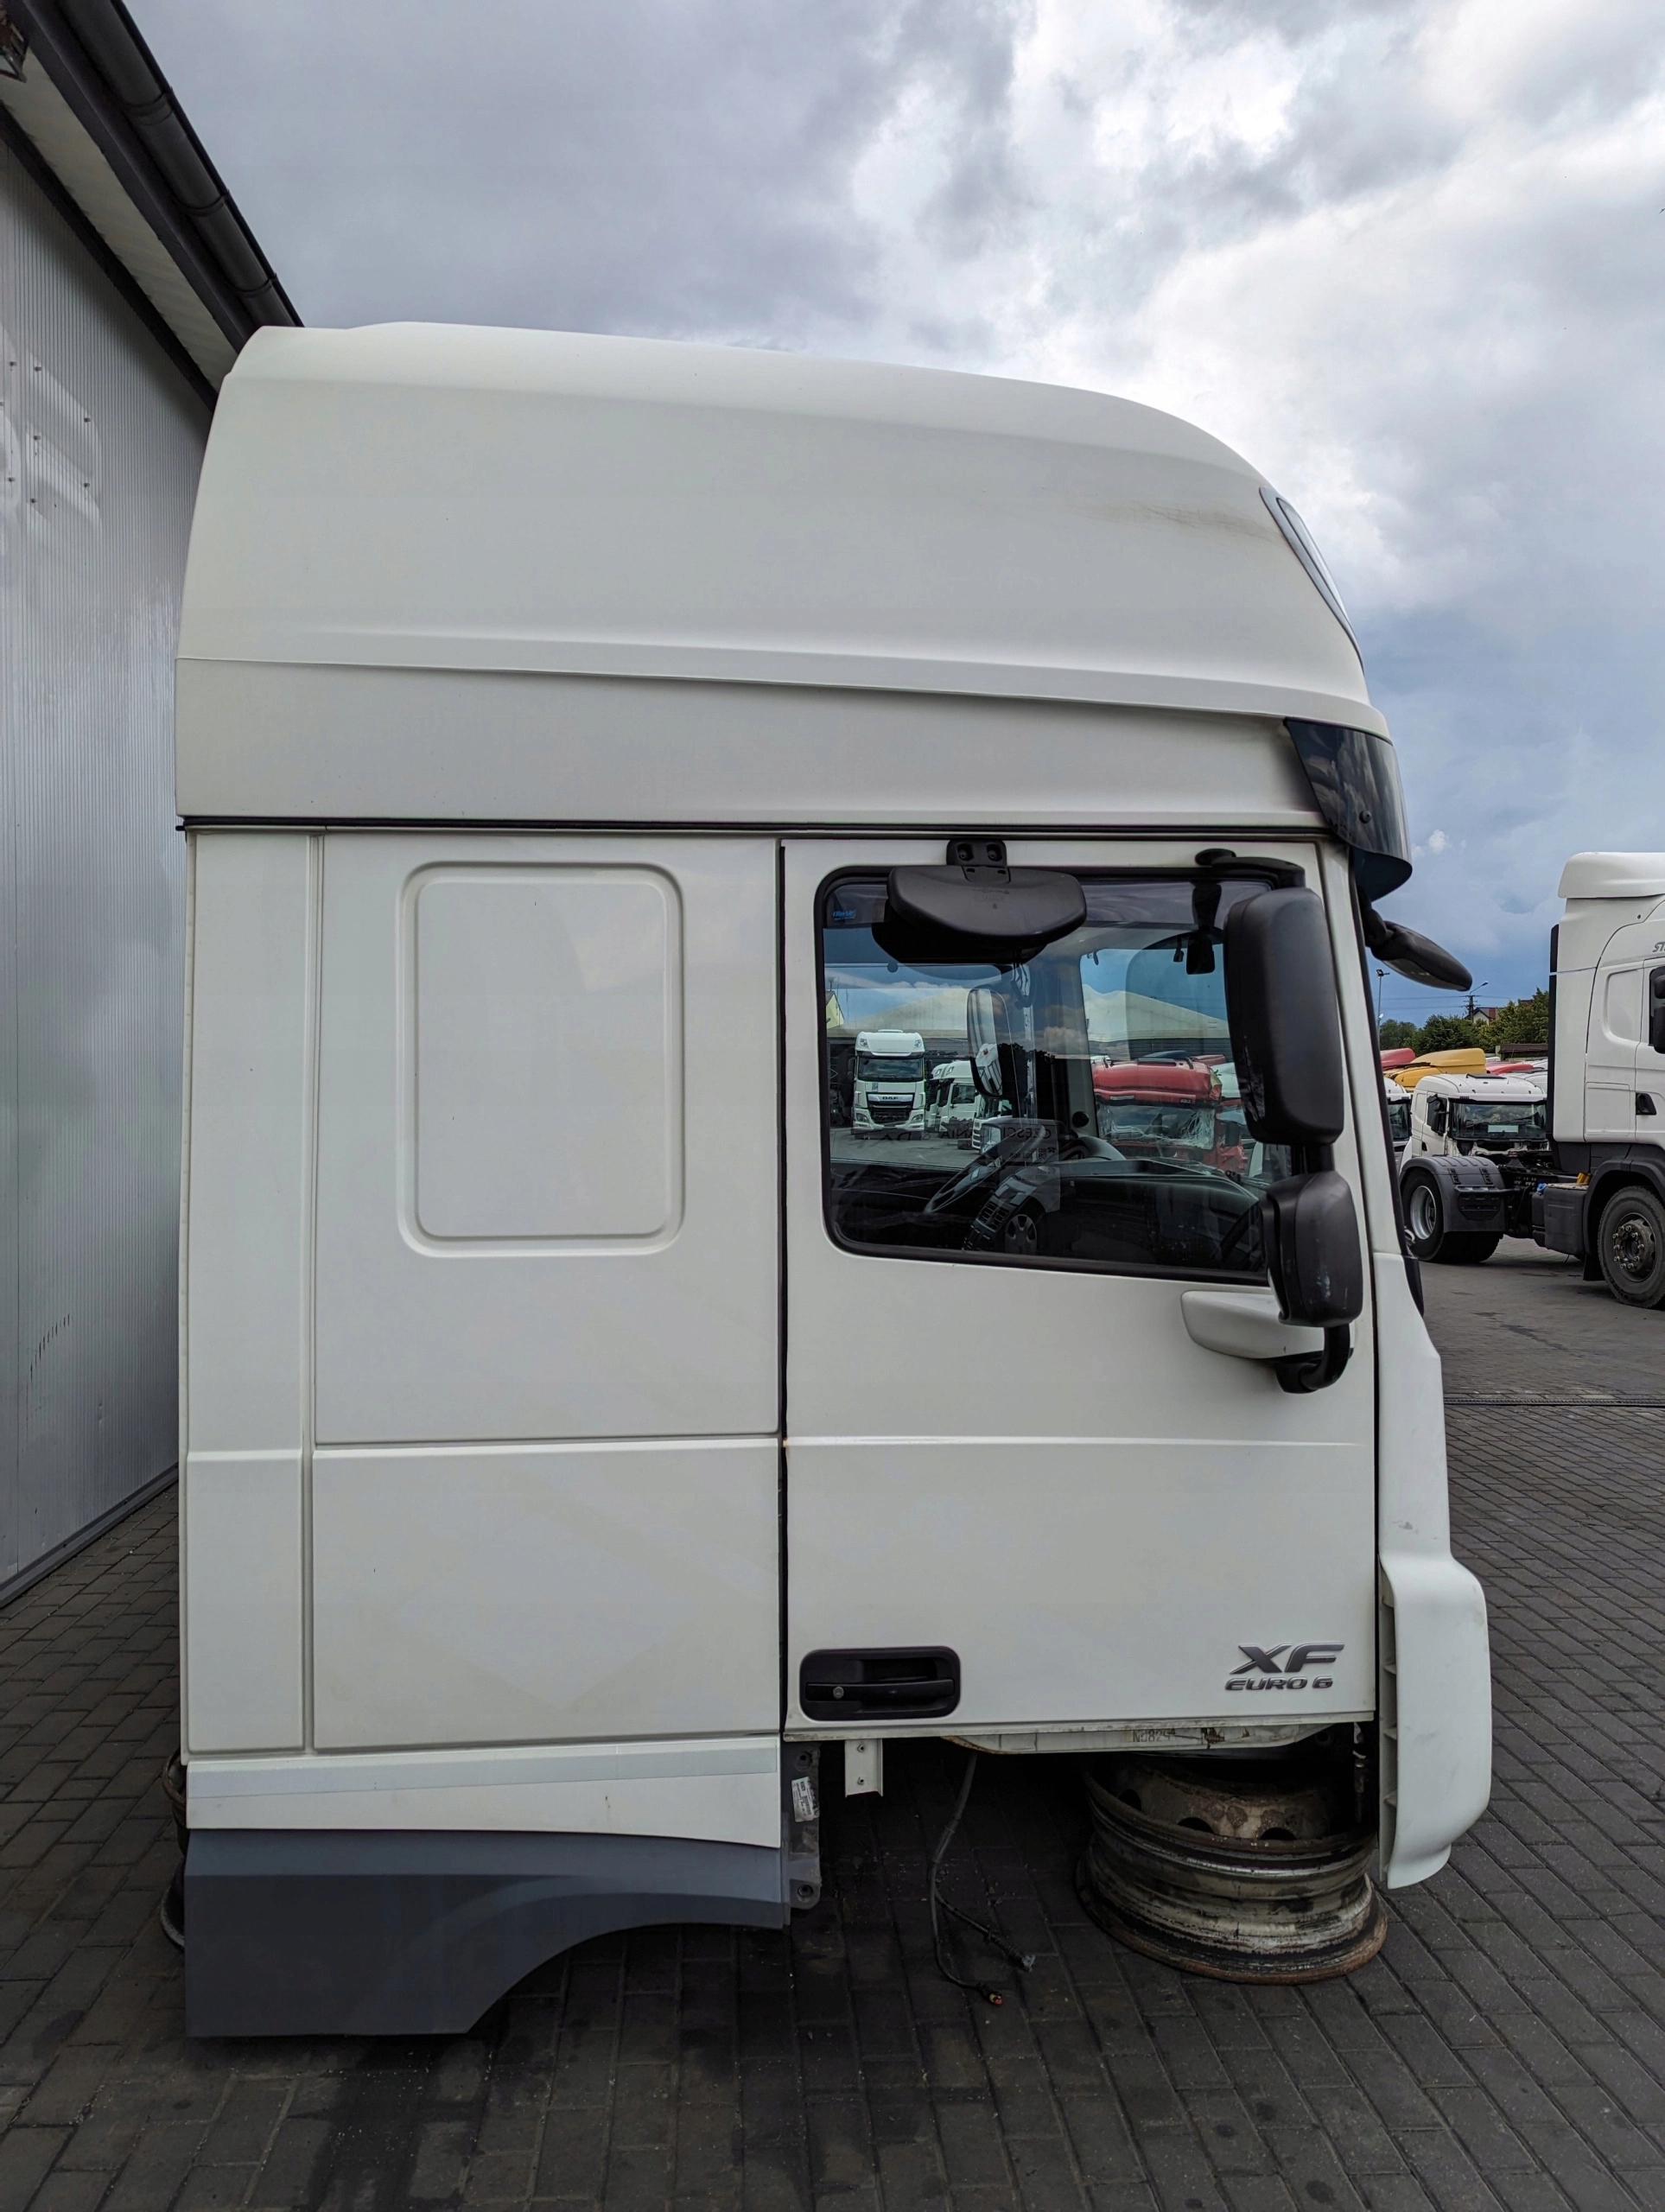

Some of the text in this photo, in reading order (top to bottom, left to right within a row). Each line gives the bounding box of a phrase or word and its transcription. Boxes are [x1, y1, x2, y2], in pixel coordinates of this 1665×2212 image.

[1652, 941, 1665, 952] ST
[1229, 1643, 1345, 1675] XF
[1224, 1675, 1333, 1691] EURO 6
